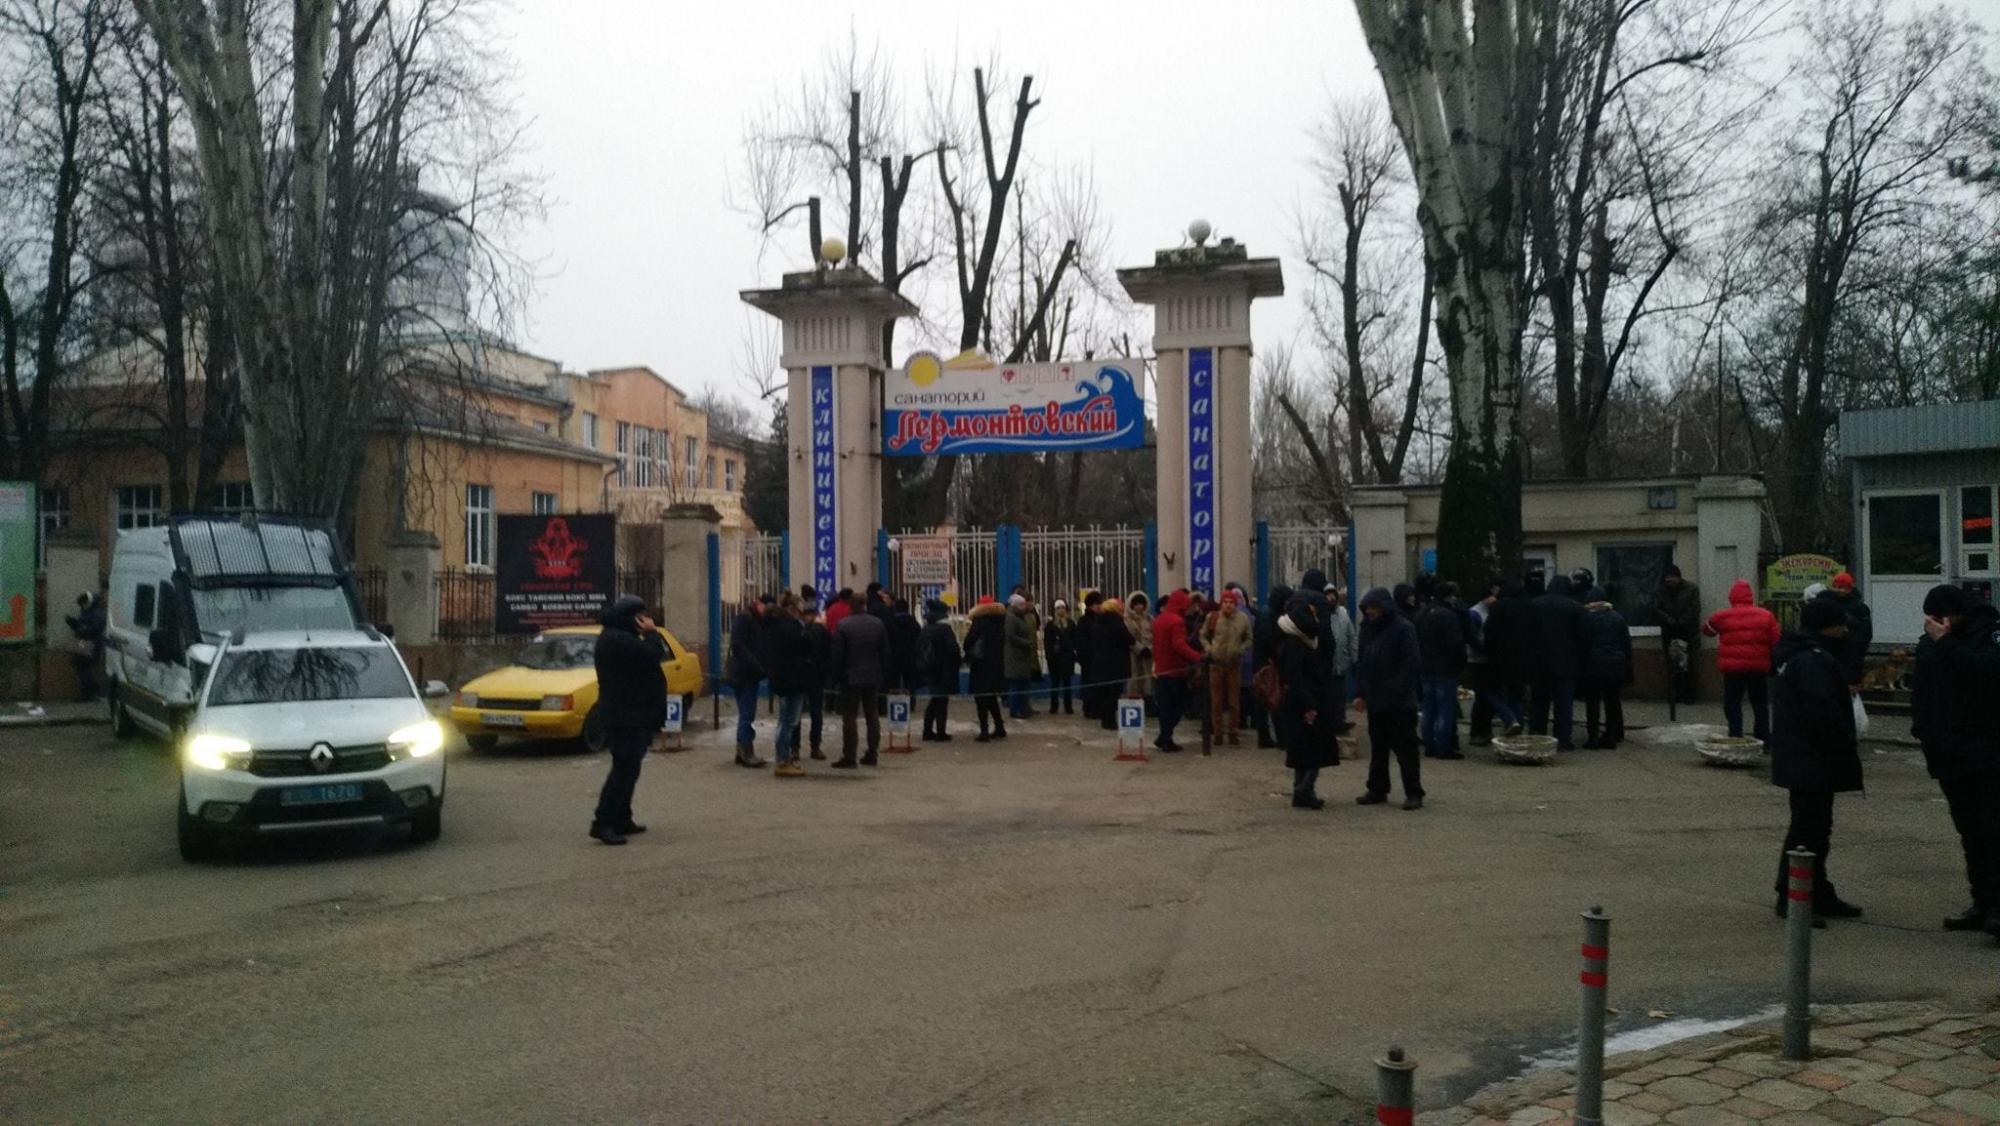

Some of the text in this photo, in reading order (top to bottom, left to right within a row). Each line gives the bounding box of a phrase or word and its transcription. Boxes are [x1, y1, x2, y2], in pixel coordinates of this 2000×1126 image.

[894, 388, 985, 406] санаторий
[888, 395, 1117, 453] Лермонтовский
[894, 704, 905, 720] P
[1125, 708, 1138, 726] P
